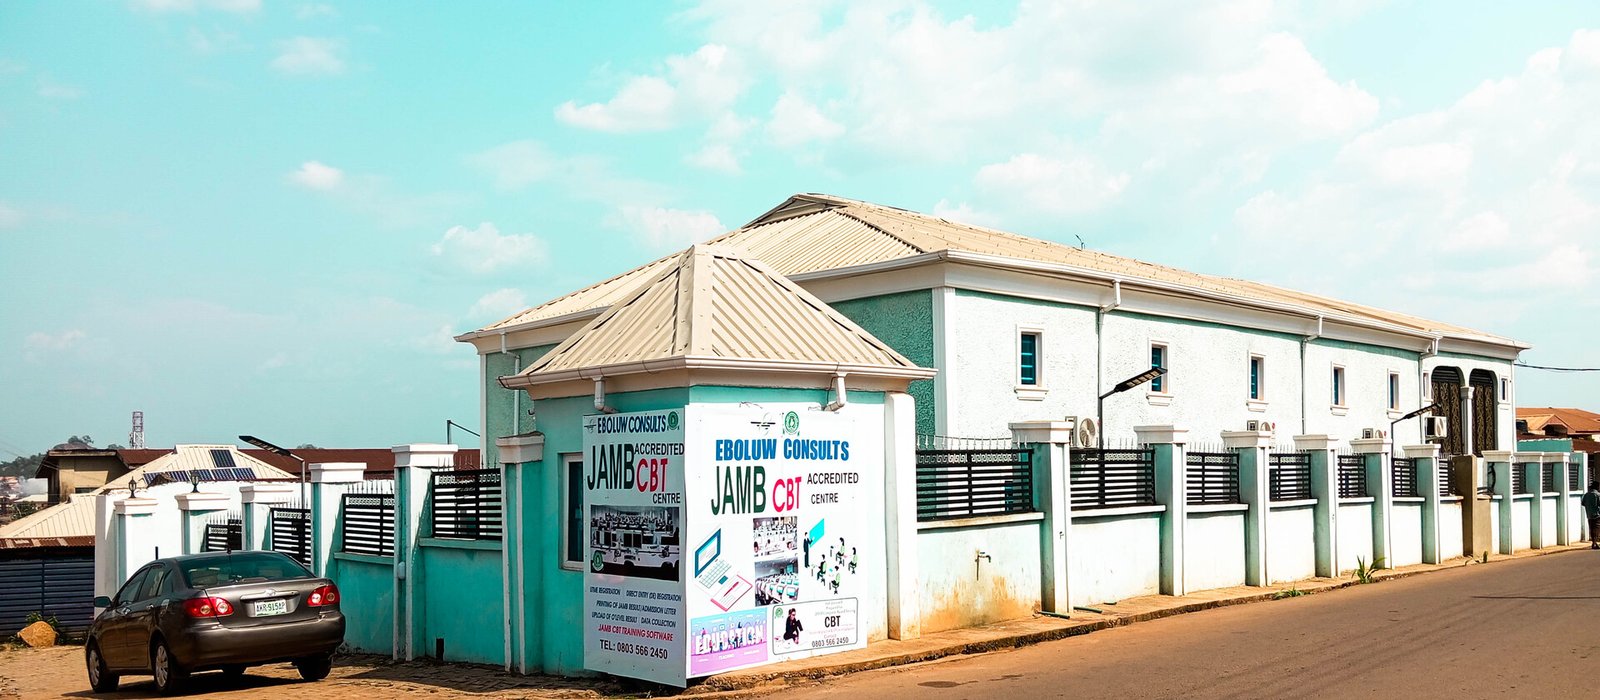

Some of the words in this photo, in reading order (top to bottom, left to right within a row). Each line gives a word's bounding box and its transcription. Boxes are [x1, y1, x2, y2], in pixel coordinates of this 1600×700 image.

[597, 416, 628, 434] EBOLUW
[628, 415, 667, 434] CONSULTS
[634, 443, 685, 456] ACCREDITED
[715, 438, 777, 461] EBOLUW
[783, 438, 849, 461] CONSULTS
[587, 444, 635, 490] JAMB
[636, 458, 668, 492] CBT
[807, 472, 859, 485] ACCREDITED
[711, 466, 767, 515] JAMB
[772, 476, 802, 513] CBT
[652, 493, 681, 504] CENTRE
[811, 492, 839, 505] CENTRE
[626, 590, 638, 598] DIRECT
[657, 593, 682, 602] REGISTRATION
[596, 600, 612, 608] PRINTING
[664, 607, 676, 615] LETTER
[591, 611, 605, 619] UPLOAD
[625, 615, 638, 623] RESULT
[641, 616, 651, 625] DATA
[651, 618, 676, 628] COLLECTION
[824, 615, 841, 628] CBT
[598, 624, 611, 632] JAMB
[612, 626, 621, 634] CBT
[621, 627, 646, 638] TRAINING
[646, 630, 673, 641] SOFTWARE
[811, 639, 825, 648] 0803
[826, 638, 836, 646] 566
[836, 636, 849, 645] 2450
[600, 639, 615, 651] TEL:
[616, 642, 634, 654] 0803
[635, 645, 649, 656] 566
[650, 647, 668, 660] 2450
